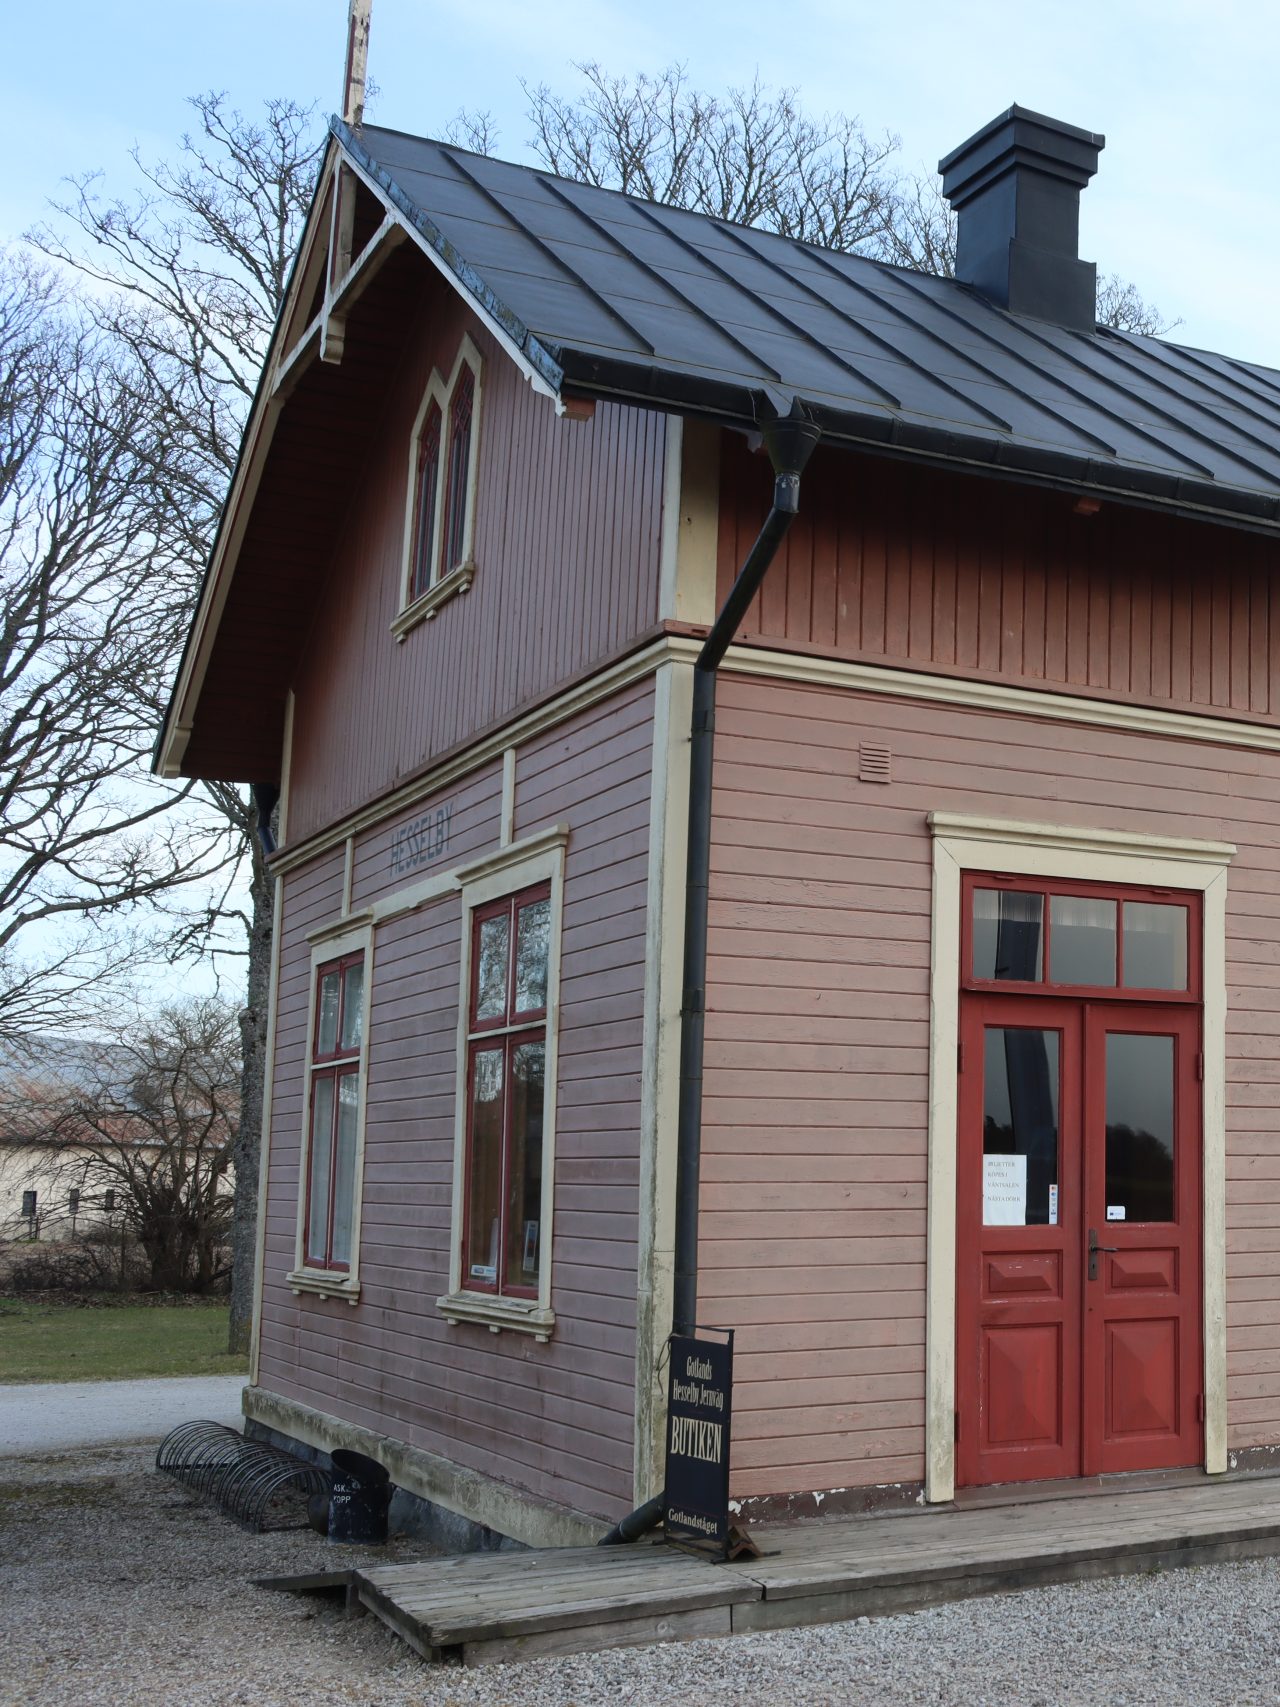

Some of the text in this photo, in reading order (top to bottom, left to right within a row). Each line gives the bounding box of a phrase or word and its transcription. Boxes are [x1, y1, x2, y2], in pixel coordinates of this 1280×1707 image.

[390, 802, 454, 877] HESSELBY
[686, 1356, 712, 1380] Gotlands
[673, 1379, 699, 1407] Hesselby
[671, 1415, 722, 1464] BUTIKEN
[668, 1508, 717, 1535] Gotlandståget
